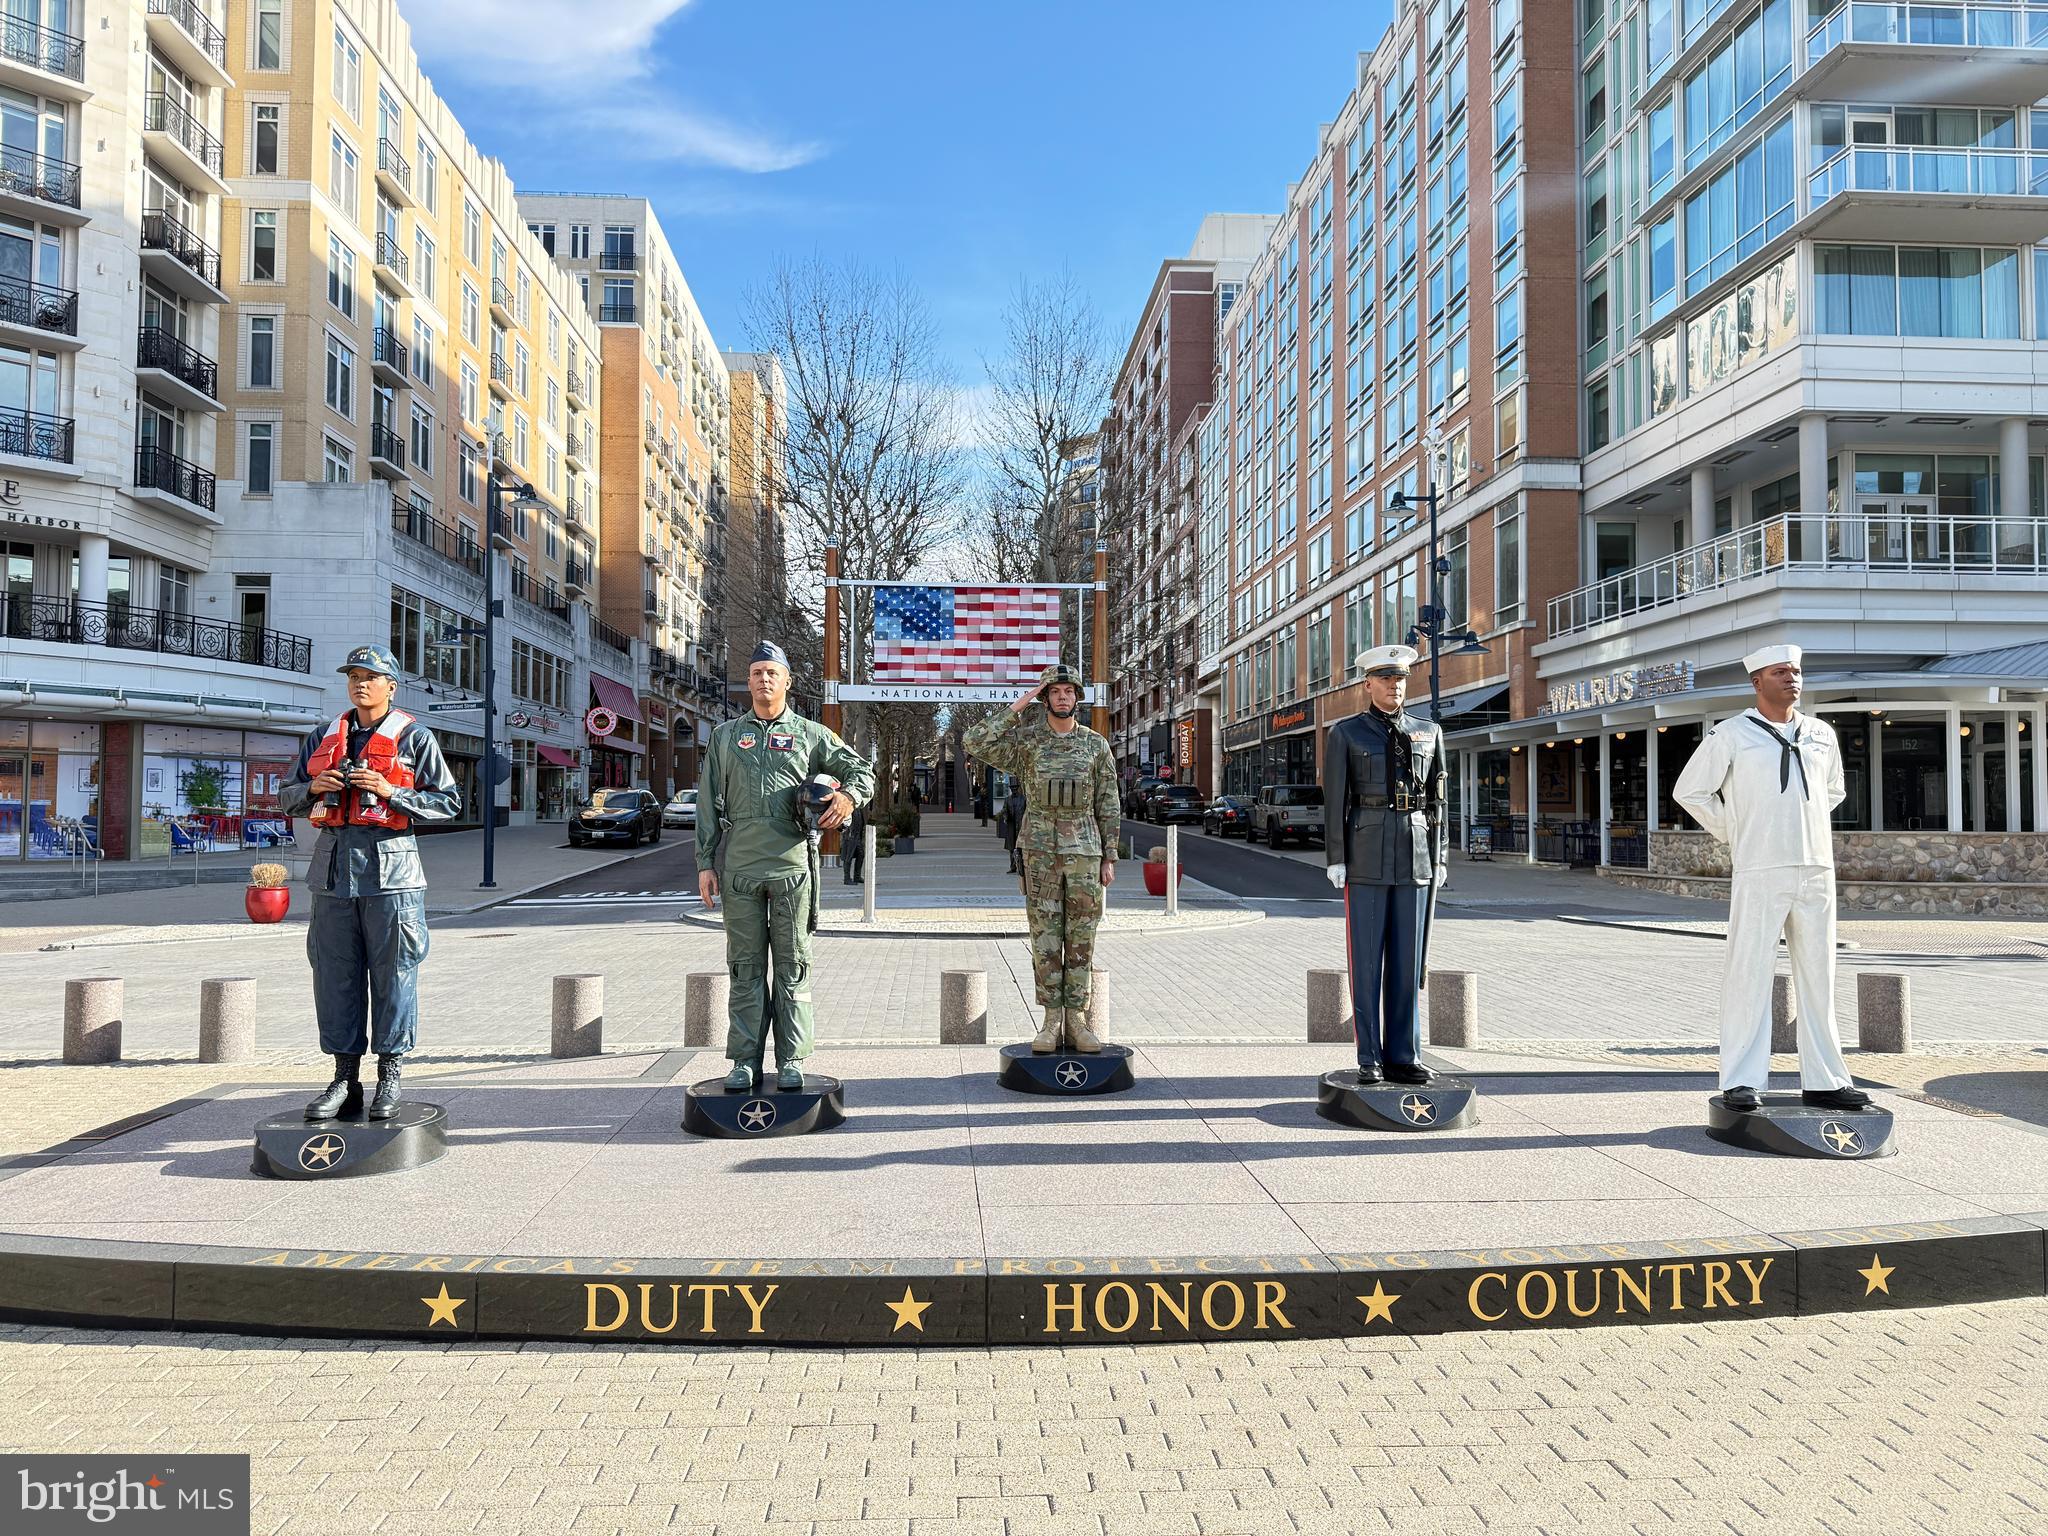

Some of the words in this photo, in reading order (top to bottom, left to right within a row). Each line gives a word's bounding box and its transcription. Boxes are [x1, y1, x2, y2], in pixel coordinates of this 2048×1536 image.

[7, 512, 81, 530] HARBOR
[881, 689, 964, 698] NATIONAL
[1550, 671, 1634, 714] WALRUS
[1181, 724, 1189, 764] BOMBAY
[1902, 739, 1918, 750] 152
[1160, 768, 1172, 776] STOP
[248, 1250, 641, 1275] AMERICA'S
[702, 1259, 898, 1276] TEAM
[951, 1253, 1433, 1276] PROTECTING
[1456, 1244, 1649, 1266] YOUR
[1660, 1221, 1969, 1257] FREEDOM
[582, 1283, 779, 1334] DUTY
[1042, 1279, 1296, 1334] HONOR
[1467, 1257, 1775, 1322] COUNTRY
